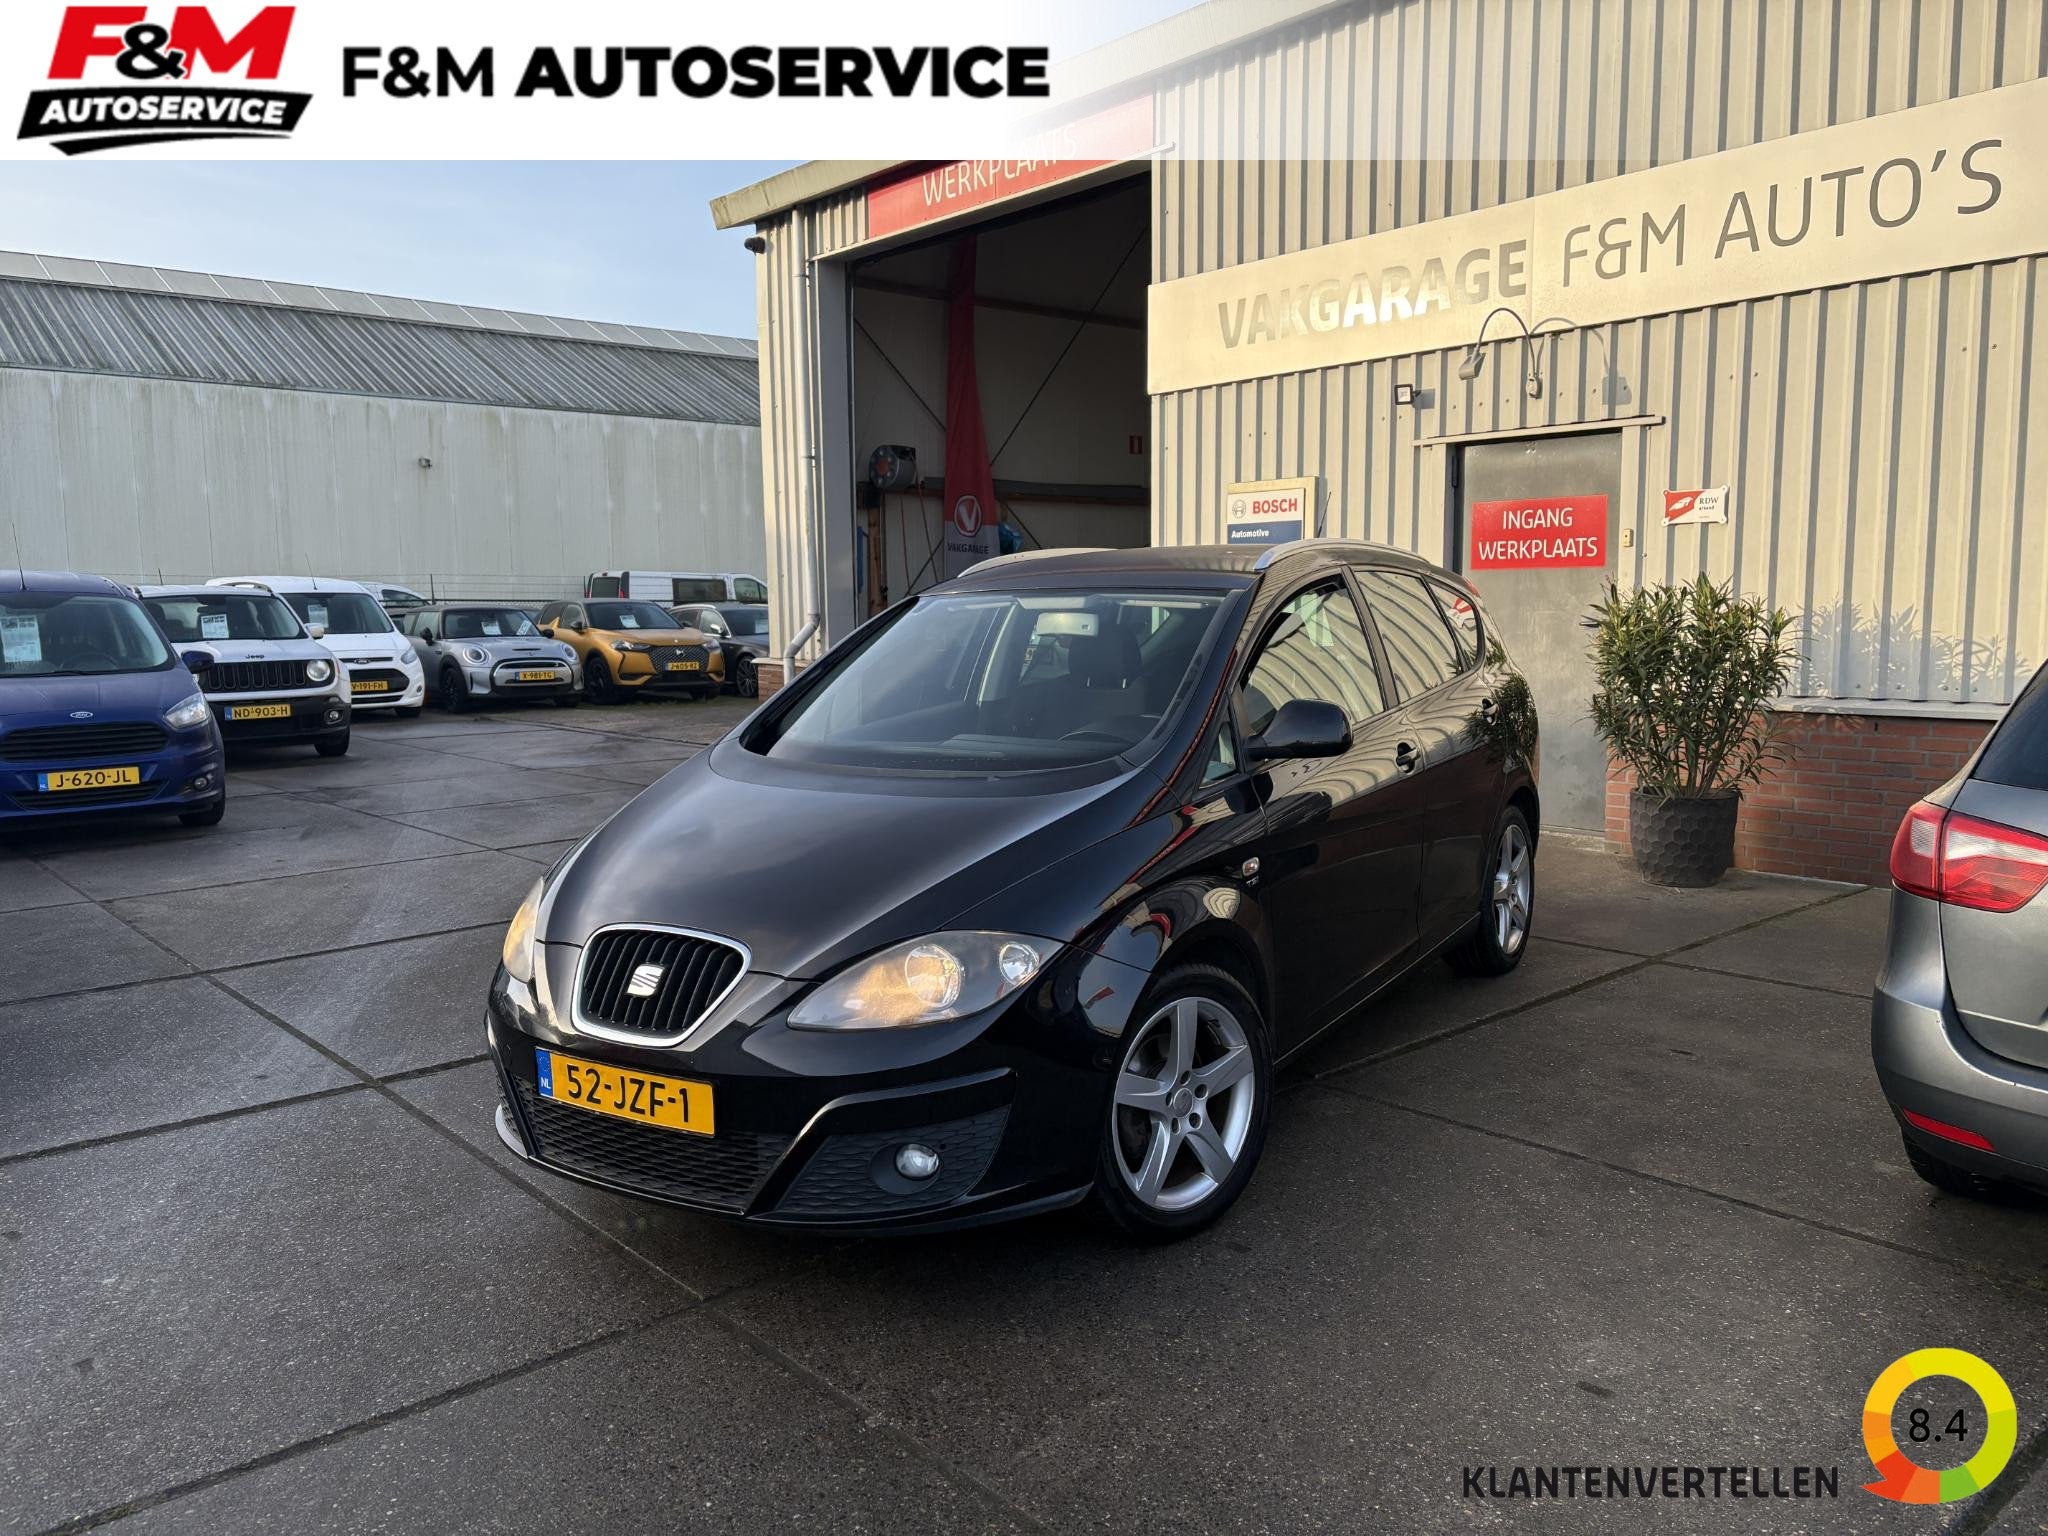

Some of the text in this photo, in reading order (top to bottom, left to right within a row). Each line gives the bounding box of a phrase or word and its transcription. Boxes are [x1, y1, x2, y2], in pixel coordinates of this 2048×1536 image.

[1217, 139, 2002, 349] VAKGARAGE F&M AUTO'S
[1252, 498, 1298, 514] BOSCH
[1502, 507, 1574, 530] INGANG
[1231, 529, 1270, 539] Automotive
[1478, 537, 1598, 560] WERKPLAATS
[234, 706, 288, 718] ND-903-H
[56, 770, 131, 788] J-620-JL
[540, 1063, 689, 1123] NL 52-JZF-1
